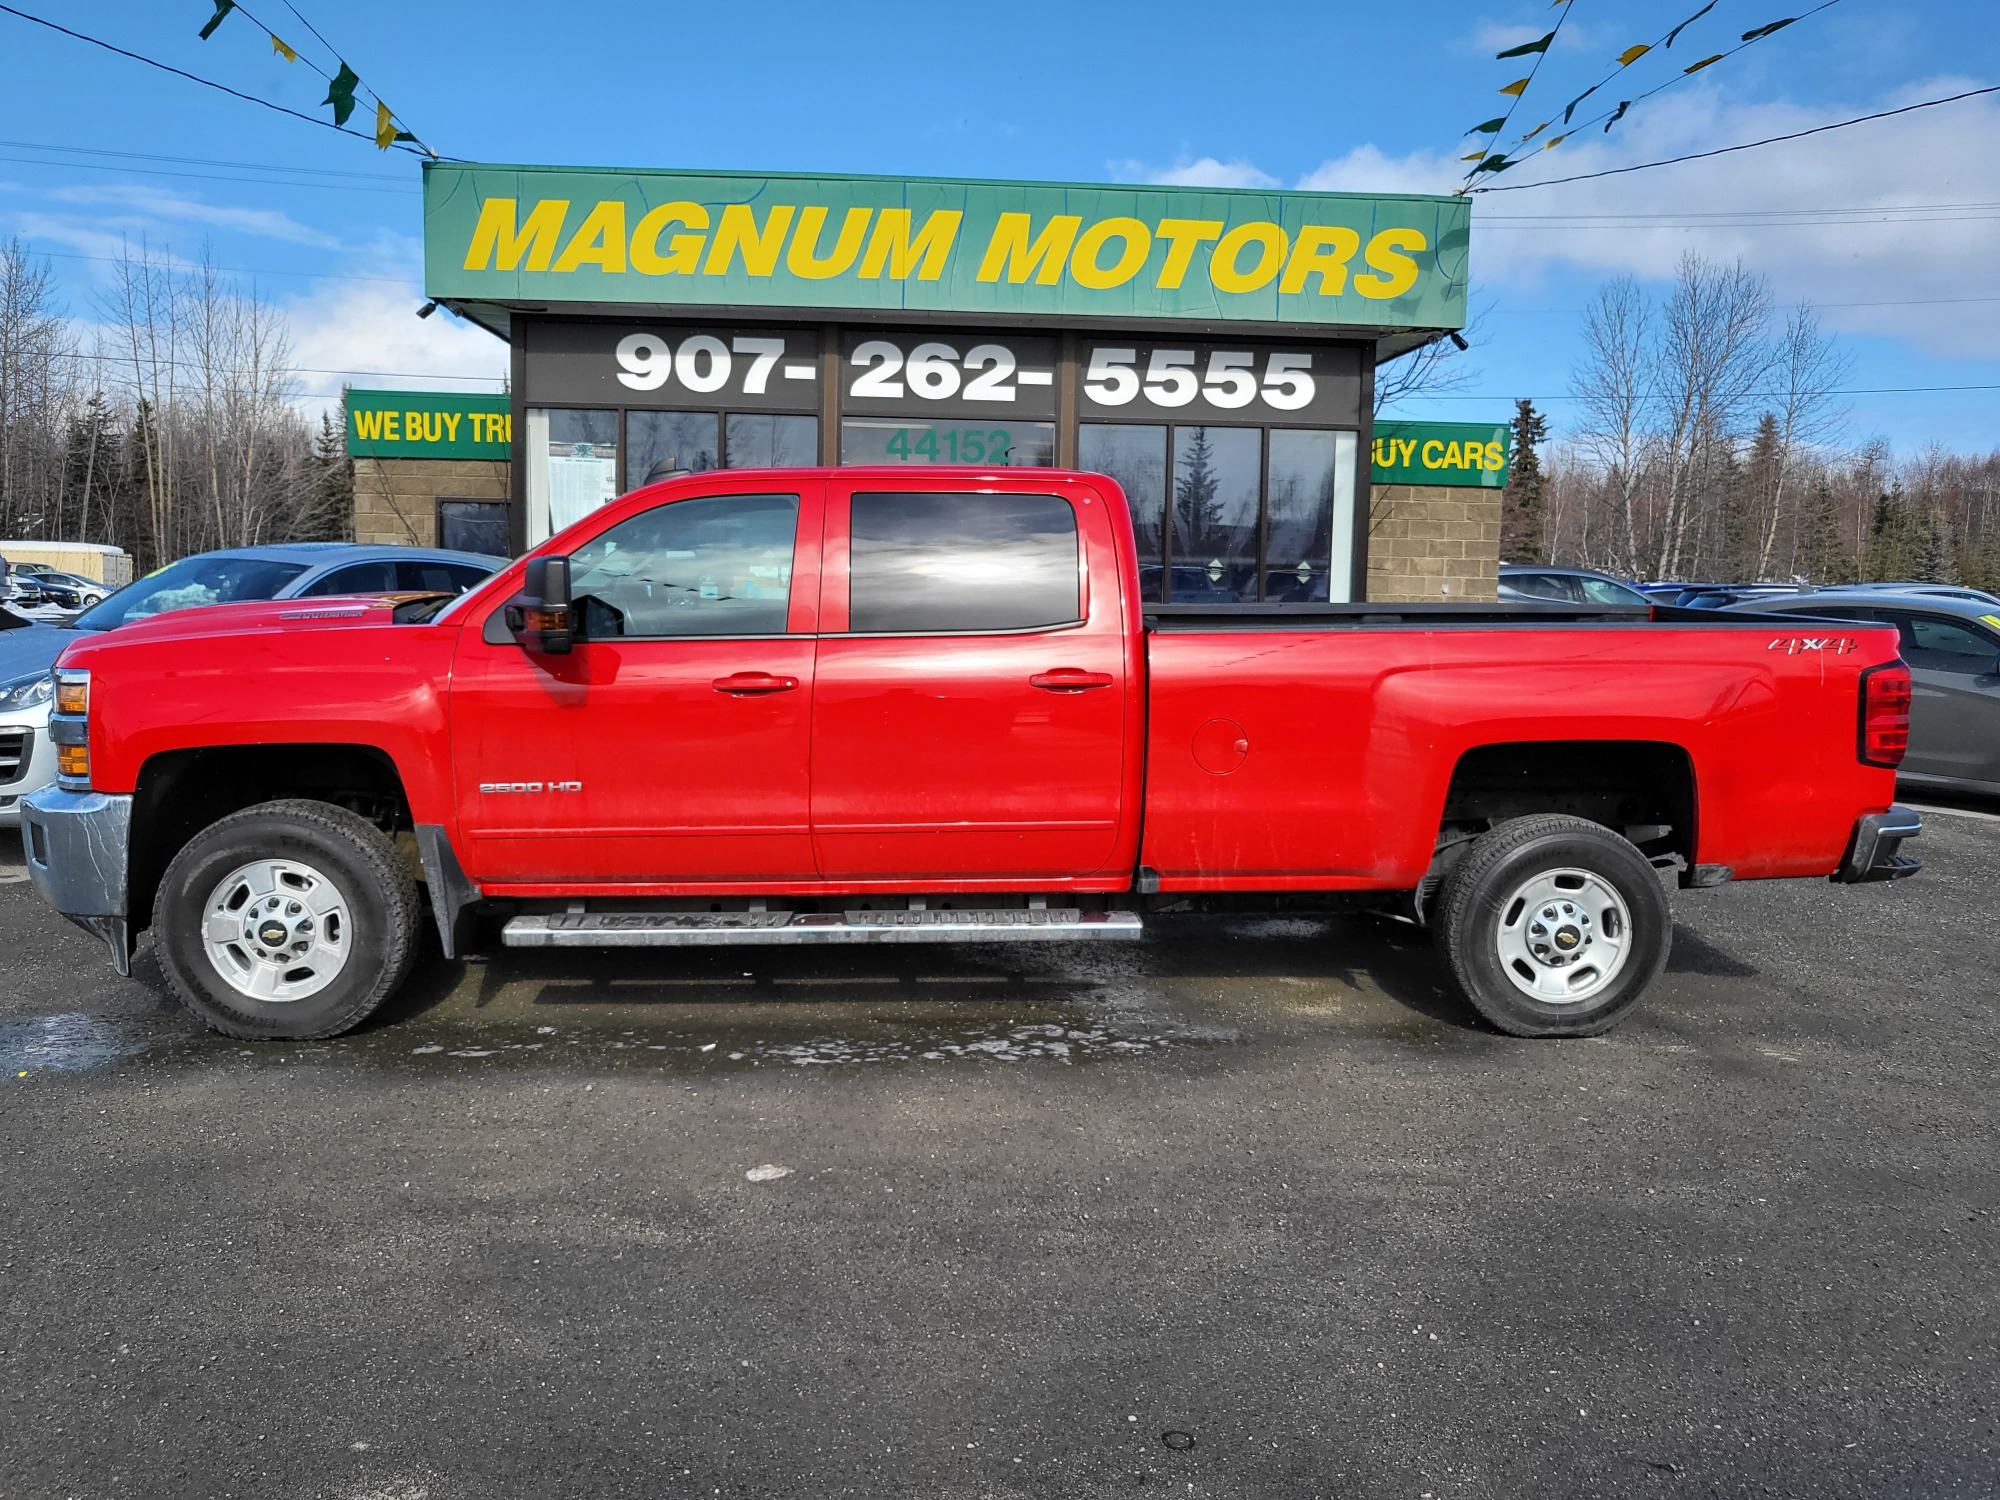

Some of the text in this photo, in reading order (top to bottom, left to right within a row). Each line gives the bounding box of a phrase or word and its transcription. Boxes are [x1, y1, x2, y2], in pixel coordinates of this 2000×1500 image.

[463, 197, 1427, 300] MAGNUM MOTORS
[615, 333, 1316, 411] 907- 262- 5555
[353, 410, 512, 443] WE BUY TR
[886, 427, 1012, 463] 44152
[1371, 438, 1504, 471] UY CARS
[479, 781, 583, 794] 2500 HD
